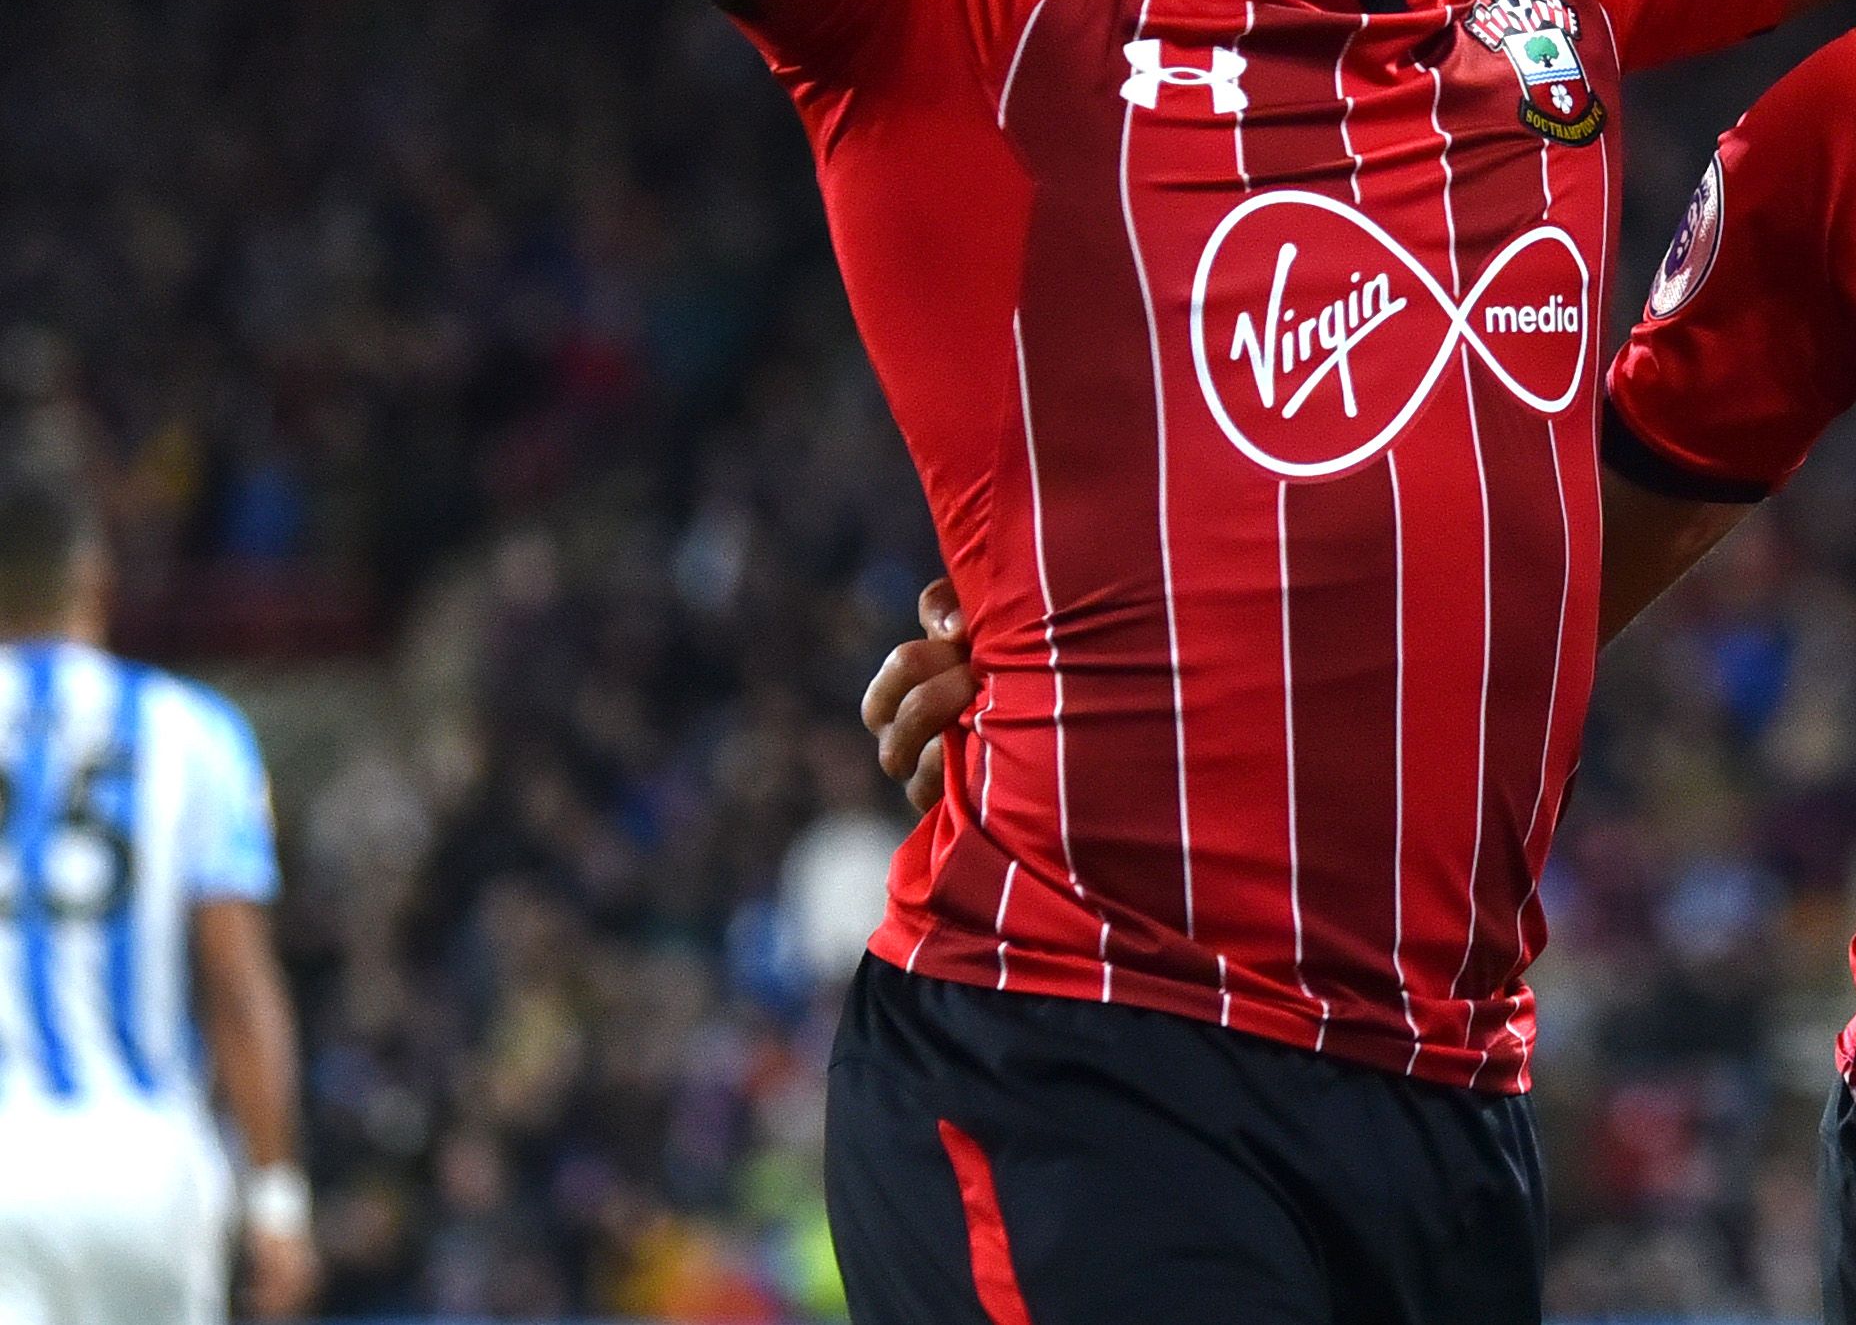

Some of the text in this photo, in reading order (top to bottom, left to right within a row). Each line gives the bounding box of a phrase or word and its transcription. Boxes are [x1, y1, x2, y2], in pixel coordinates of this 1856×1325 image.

[1526, 109, 1596, 140] SOUTHAMPTON
[1230, 242, 1578, 418] Virgin media
[0, 745, 139, 925] 5
